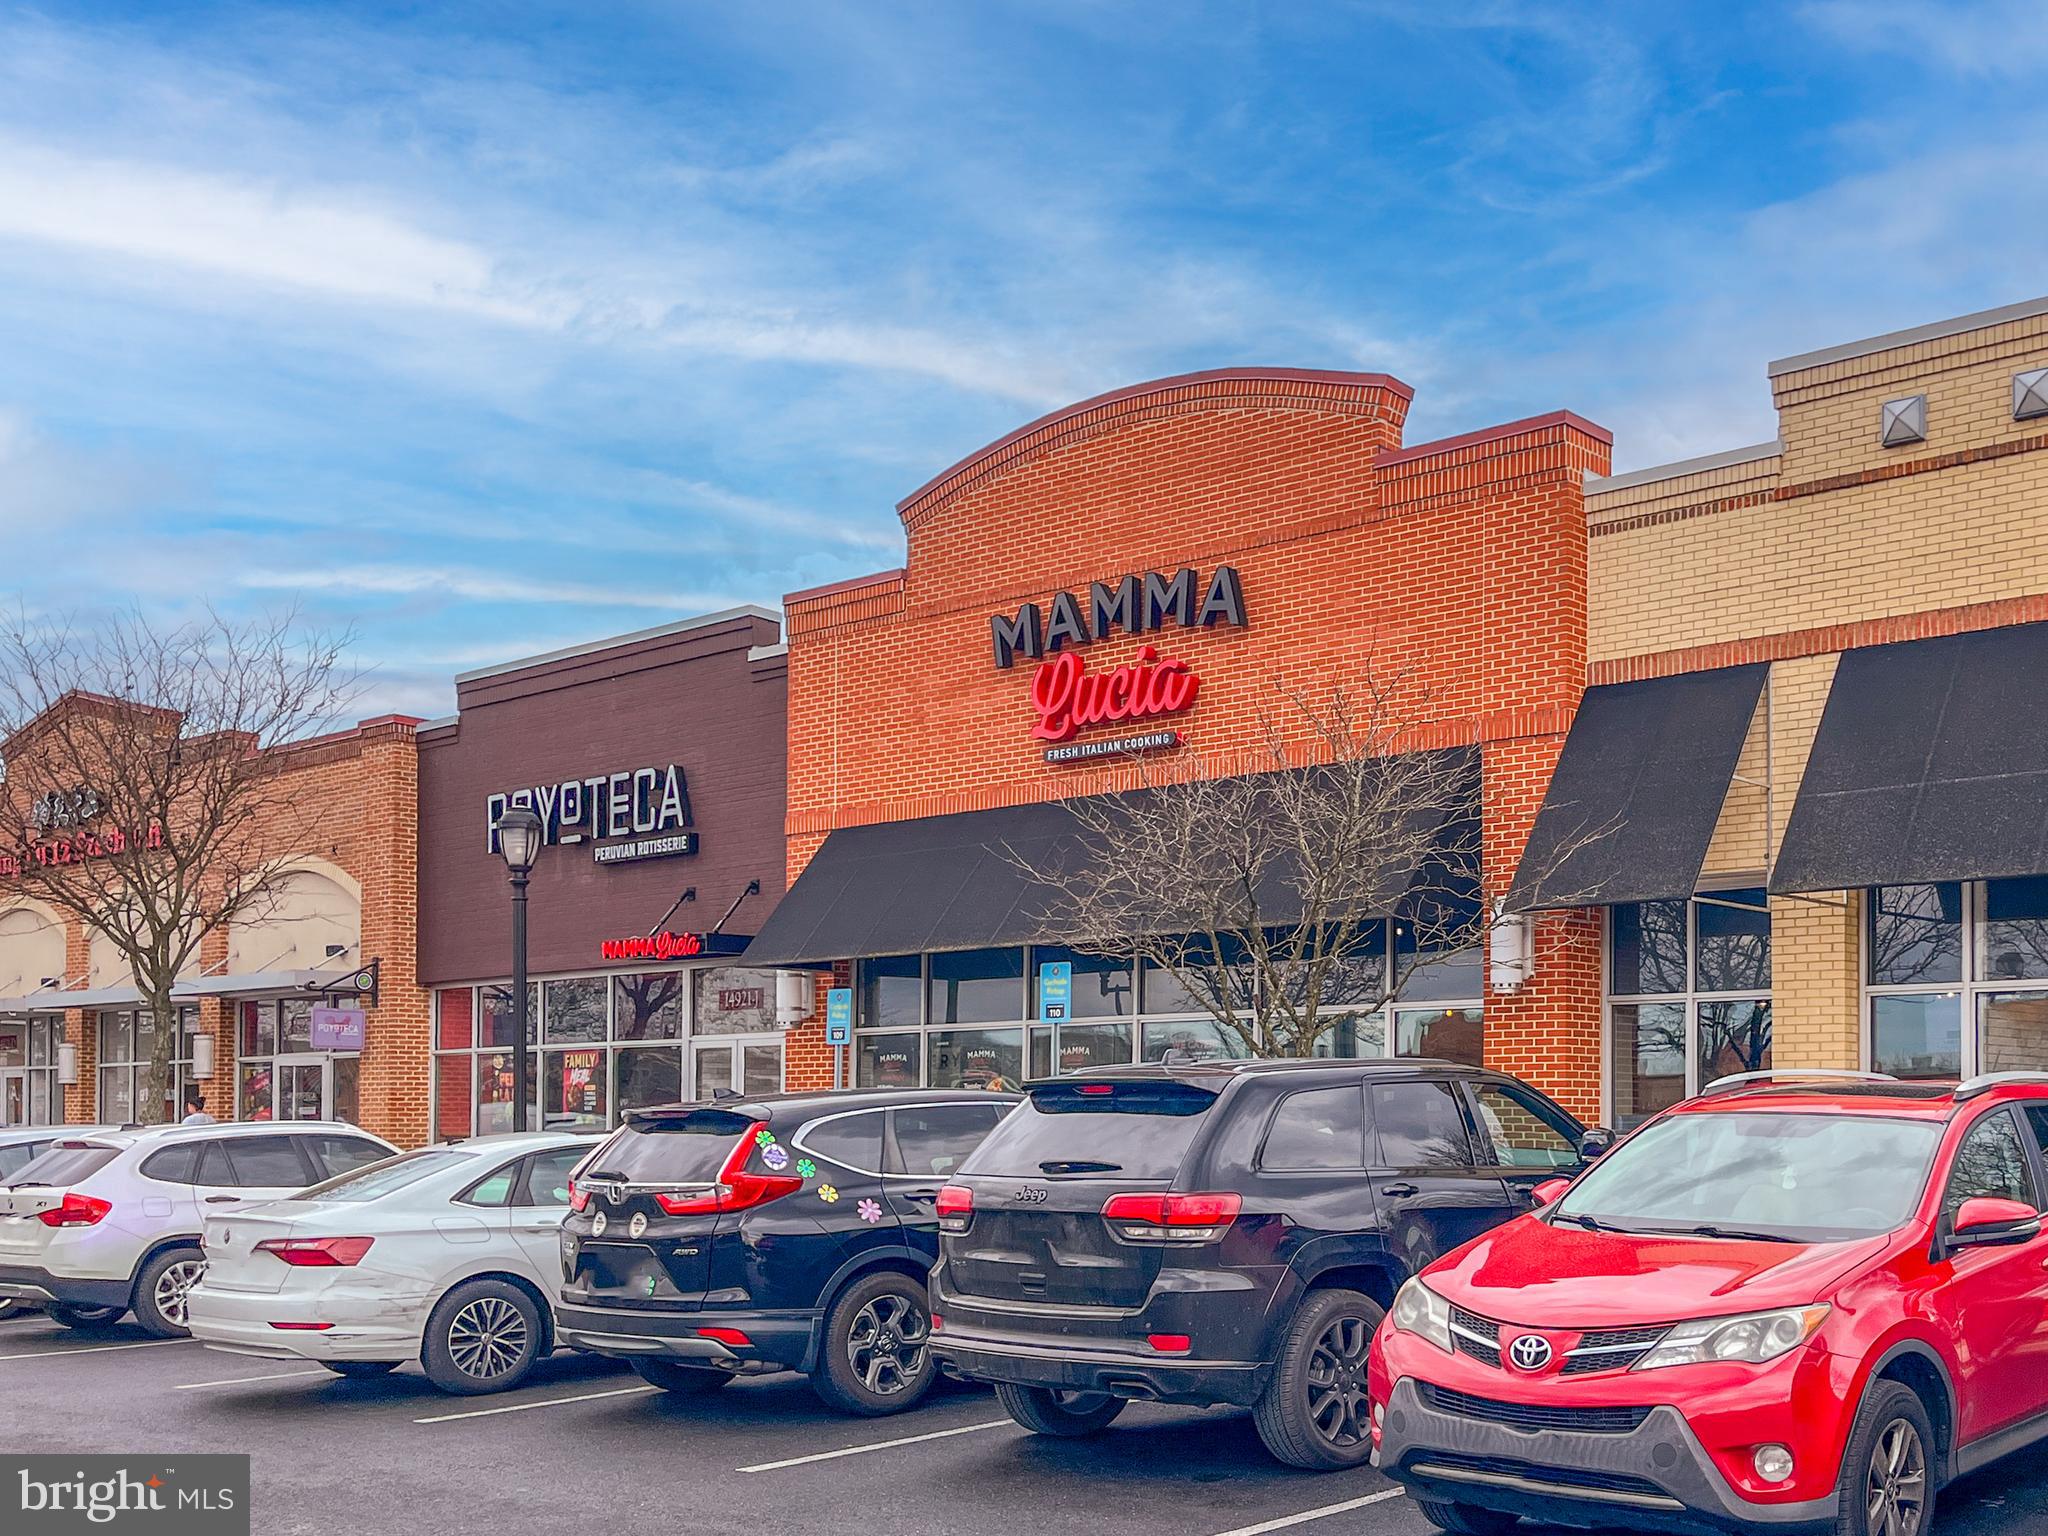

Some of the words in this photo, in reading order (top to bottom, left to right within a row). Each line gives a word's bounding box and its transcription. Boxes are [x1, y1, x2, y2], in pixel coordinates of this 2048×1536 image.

[990, 566, 1247, 669] MAMMA
[1031, 647, 1199, 741] Lucia
[1047, 748, 1078, 760] FRESH
[1081, 741, 1120, 755] ITALIAN
[1124, 734, 1169, 748] COOKING
[595, 843, 636, 862] PERUVIAN
[637, 835, 687, 856] ROTISSERIE
[601, 936, 656, 959] MAMMA
[656, 931, 700, 959] Lucia
[1049, 1008, 1061, 1017] 110
[832, 1031, 844, 1039] 109
[564, 1053, 596, 1069] FAMILY
[879, 1051, 908, 1063] MAMMA
[966, 1050, 996, 1059] MAMMA
[570, 1067, 590, 1085] MEAL
[1015, 1186, 1048, 1204] Jeep
[672, 1248, 699, 1256] AWD
